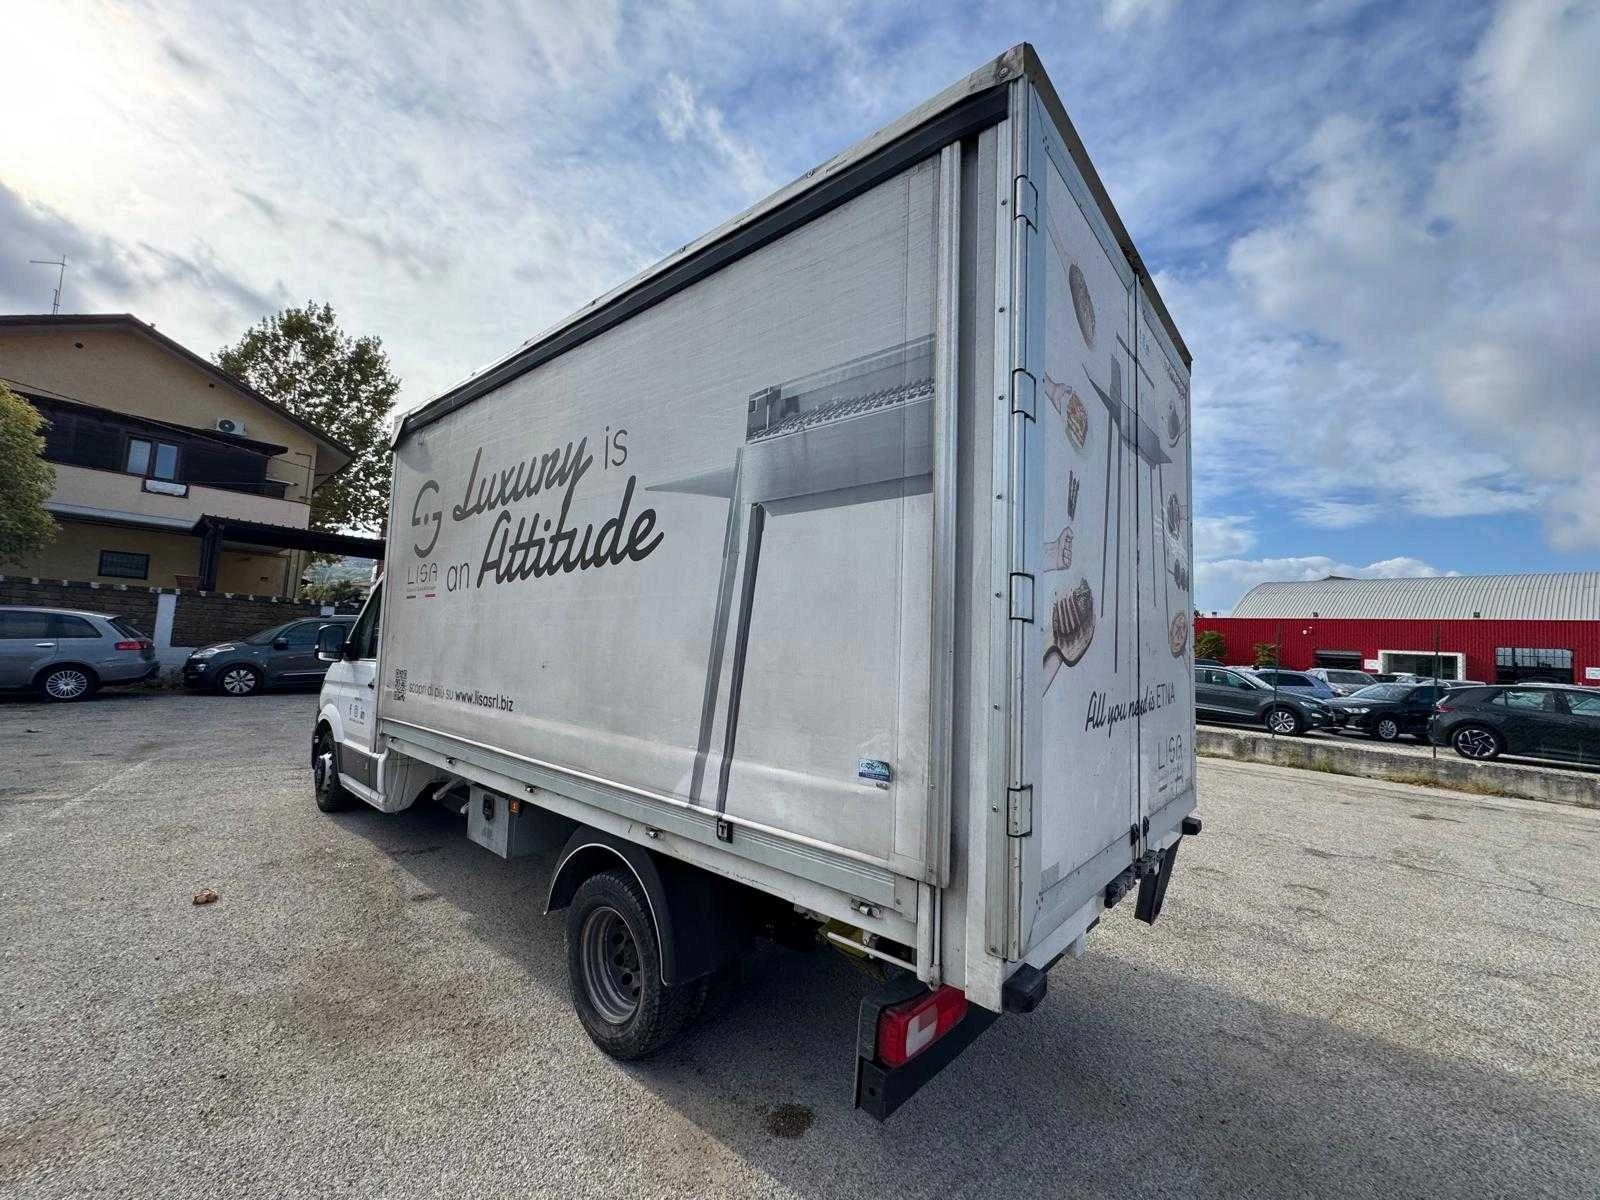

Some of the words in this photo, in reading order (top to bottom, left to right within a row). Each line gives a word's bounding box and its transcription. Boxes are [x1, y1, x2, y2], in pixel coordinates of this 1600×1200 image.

[452, 436, 594, 523] Luxury
[604, 425, 628, 470] is
[446, 562, 470, 592] an
[476, 474, 665, 589] Attitude
[407, 562, 438, 585] LISA
[455, 689, 514, 712] www.lisasrl.biz
[1085, 691, 1107, 732] All
[1107, 702, 1127, 739] you
[1157, 734, 1183, 770] LISA
